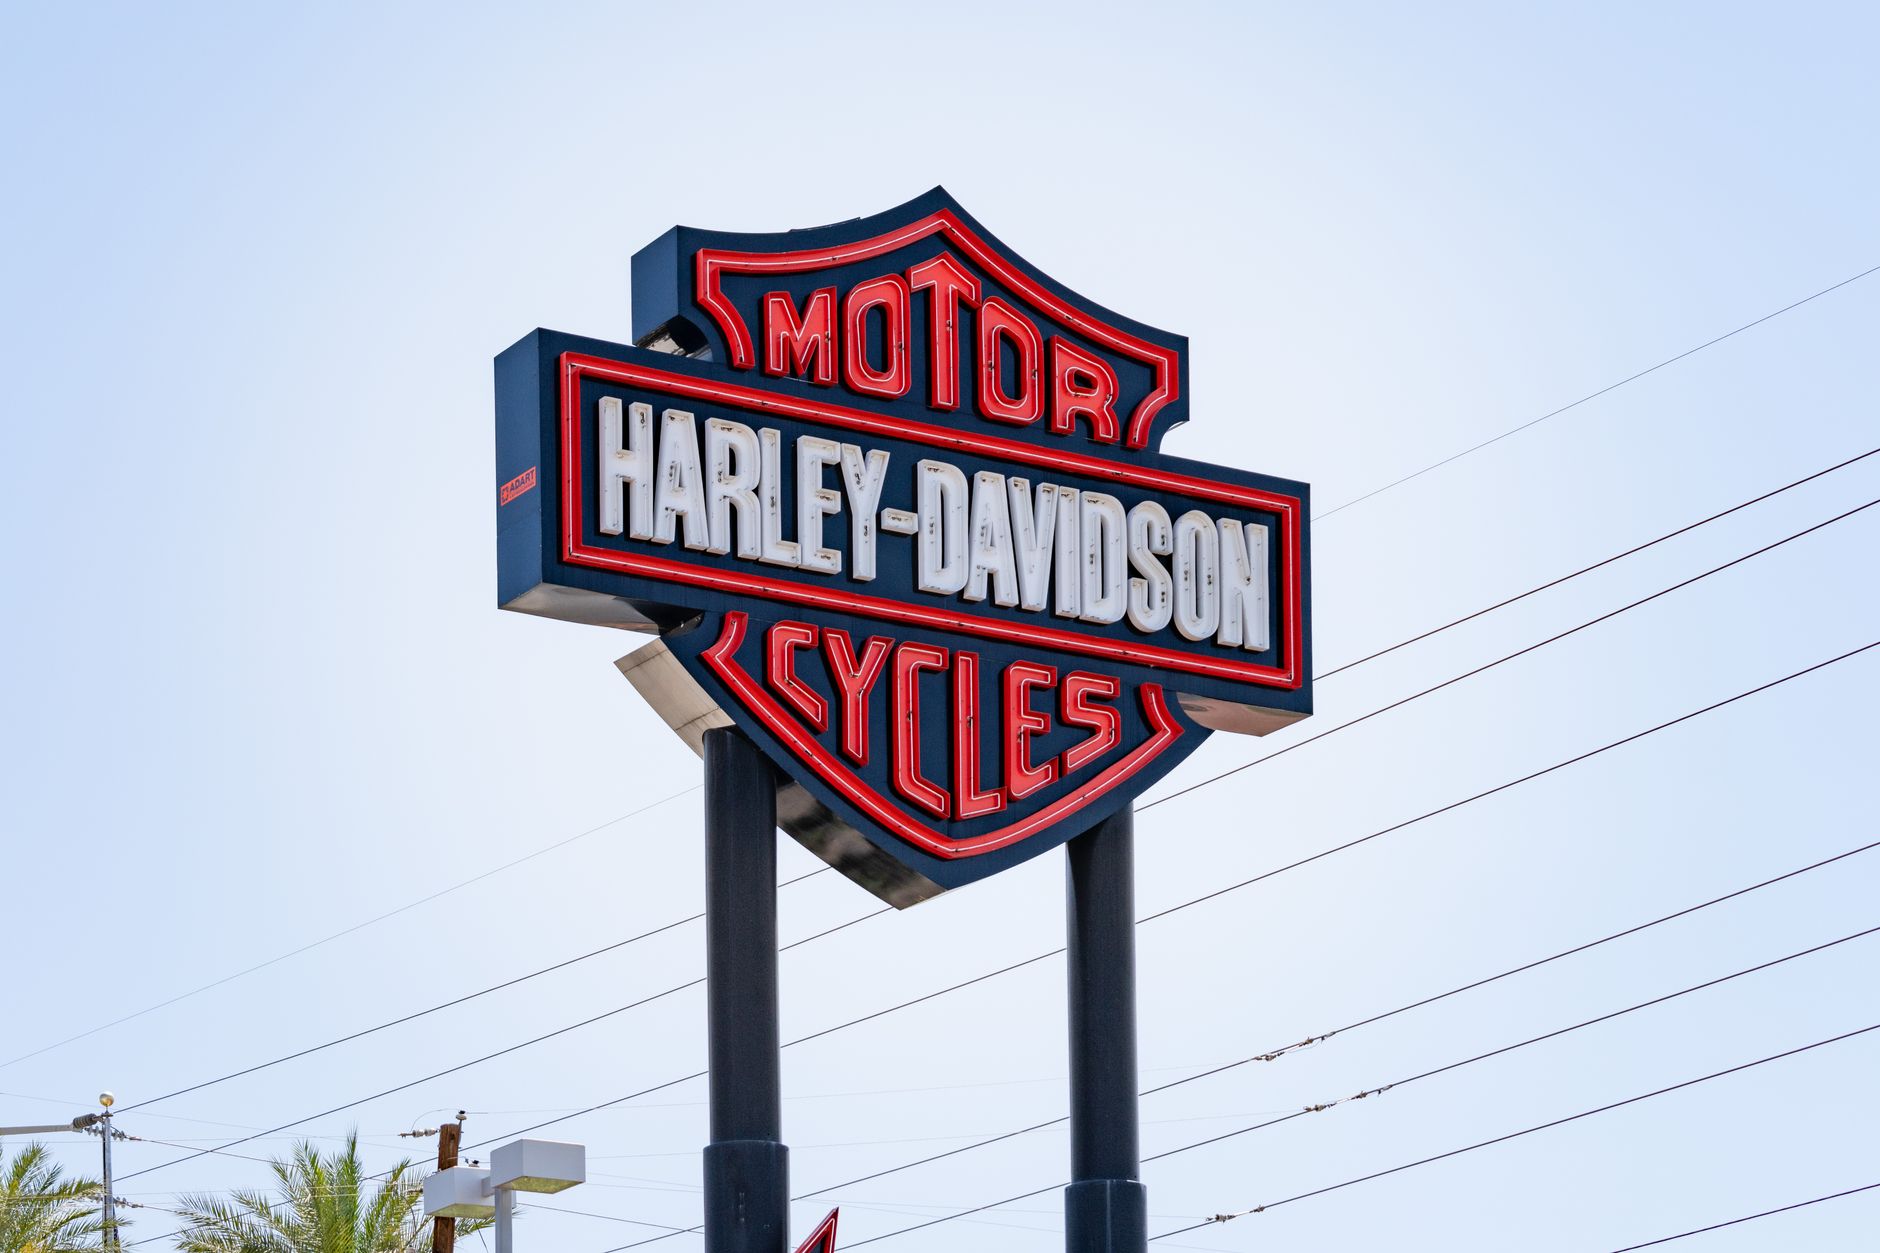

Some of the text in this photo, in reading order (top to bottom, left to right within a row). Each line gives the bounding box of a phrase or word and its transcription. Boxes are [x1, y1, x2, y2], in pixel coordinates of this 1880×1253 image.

[763, 251, 1121, 443] MOTOR
[597, 396, 1270, 653] HARLEY-DAVIDSON
[766, 619, 1122, 821] CYCLES
